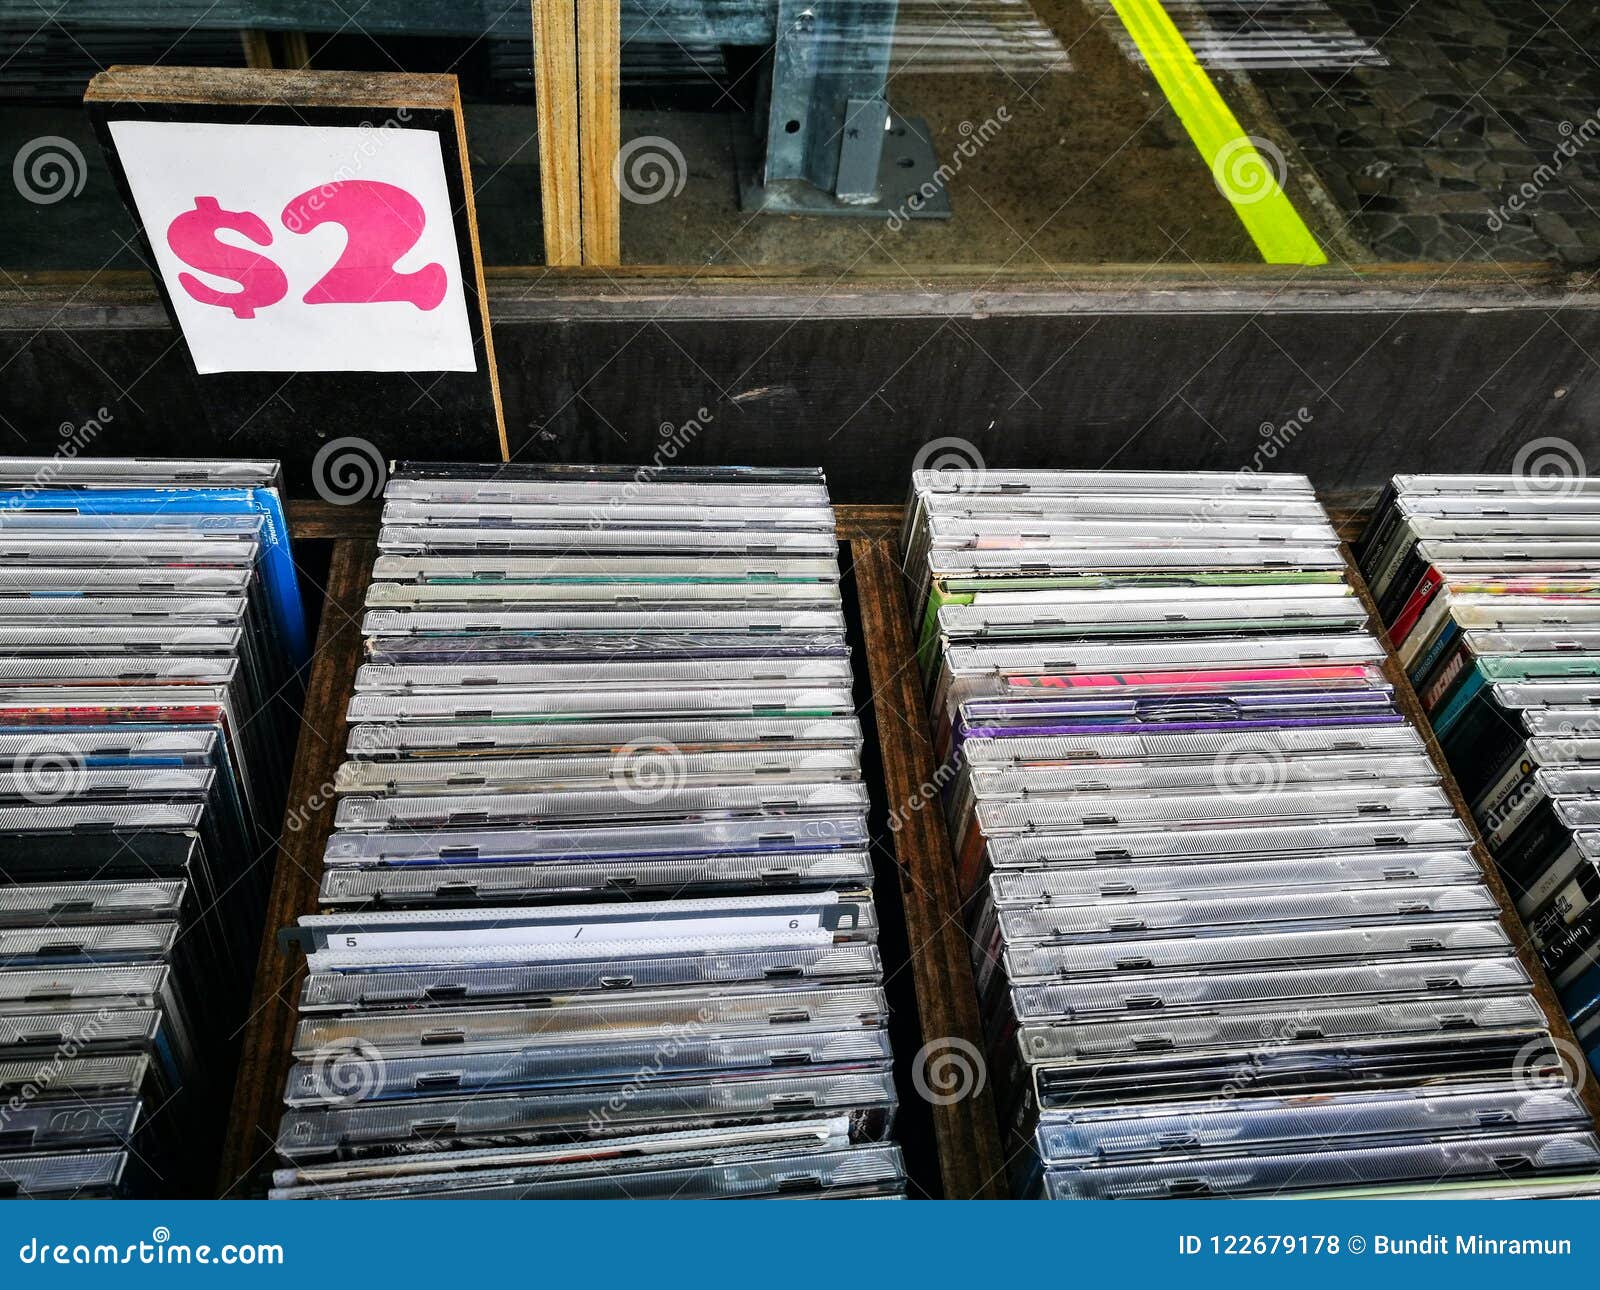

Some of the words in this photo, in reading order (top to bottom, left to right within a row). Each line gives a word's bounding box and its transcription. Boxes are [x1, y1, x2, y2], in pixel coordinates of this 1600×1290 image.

[166, 179, 448, 319] $2
[345, 936, 358, 948] 5
[788, 919, 799, 929] 6
